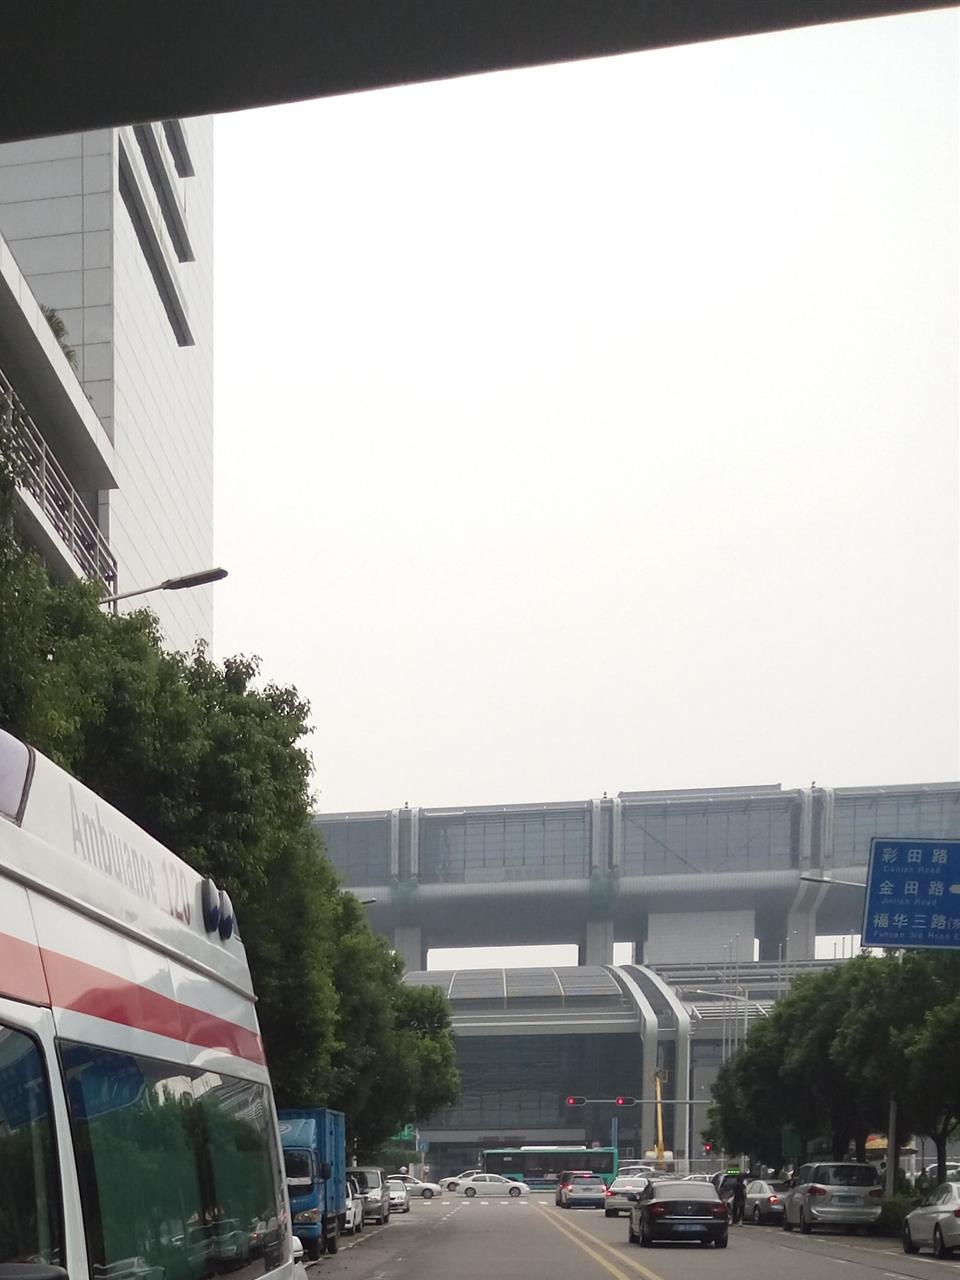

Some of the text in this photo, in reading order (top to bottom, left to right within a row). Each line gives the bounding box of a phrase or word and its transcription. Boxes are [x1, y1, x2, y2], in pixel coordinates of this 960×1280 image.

[881, 847, 948, 864] 彩田路
[161, 858, 192, 926] 120
[879, 879, 945, 897] 金田路
